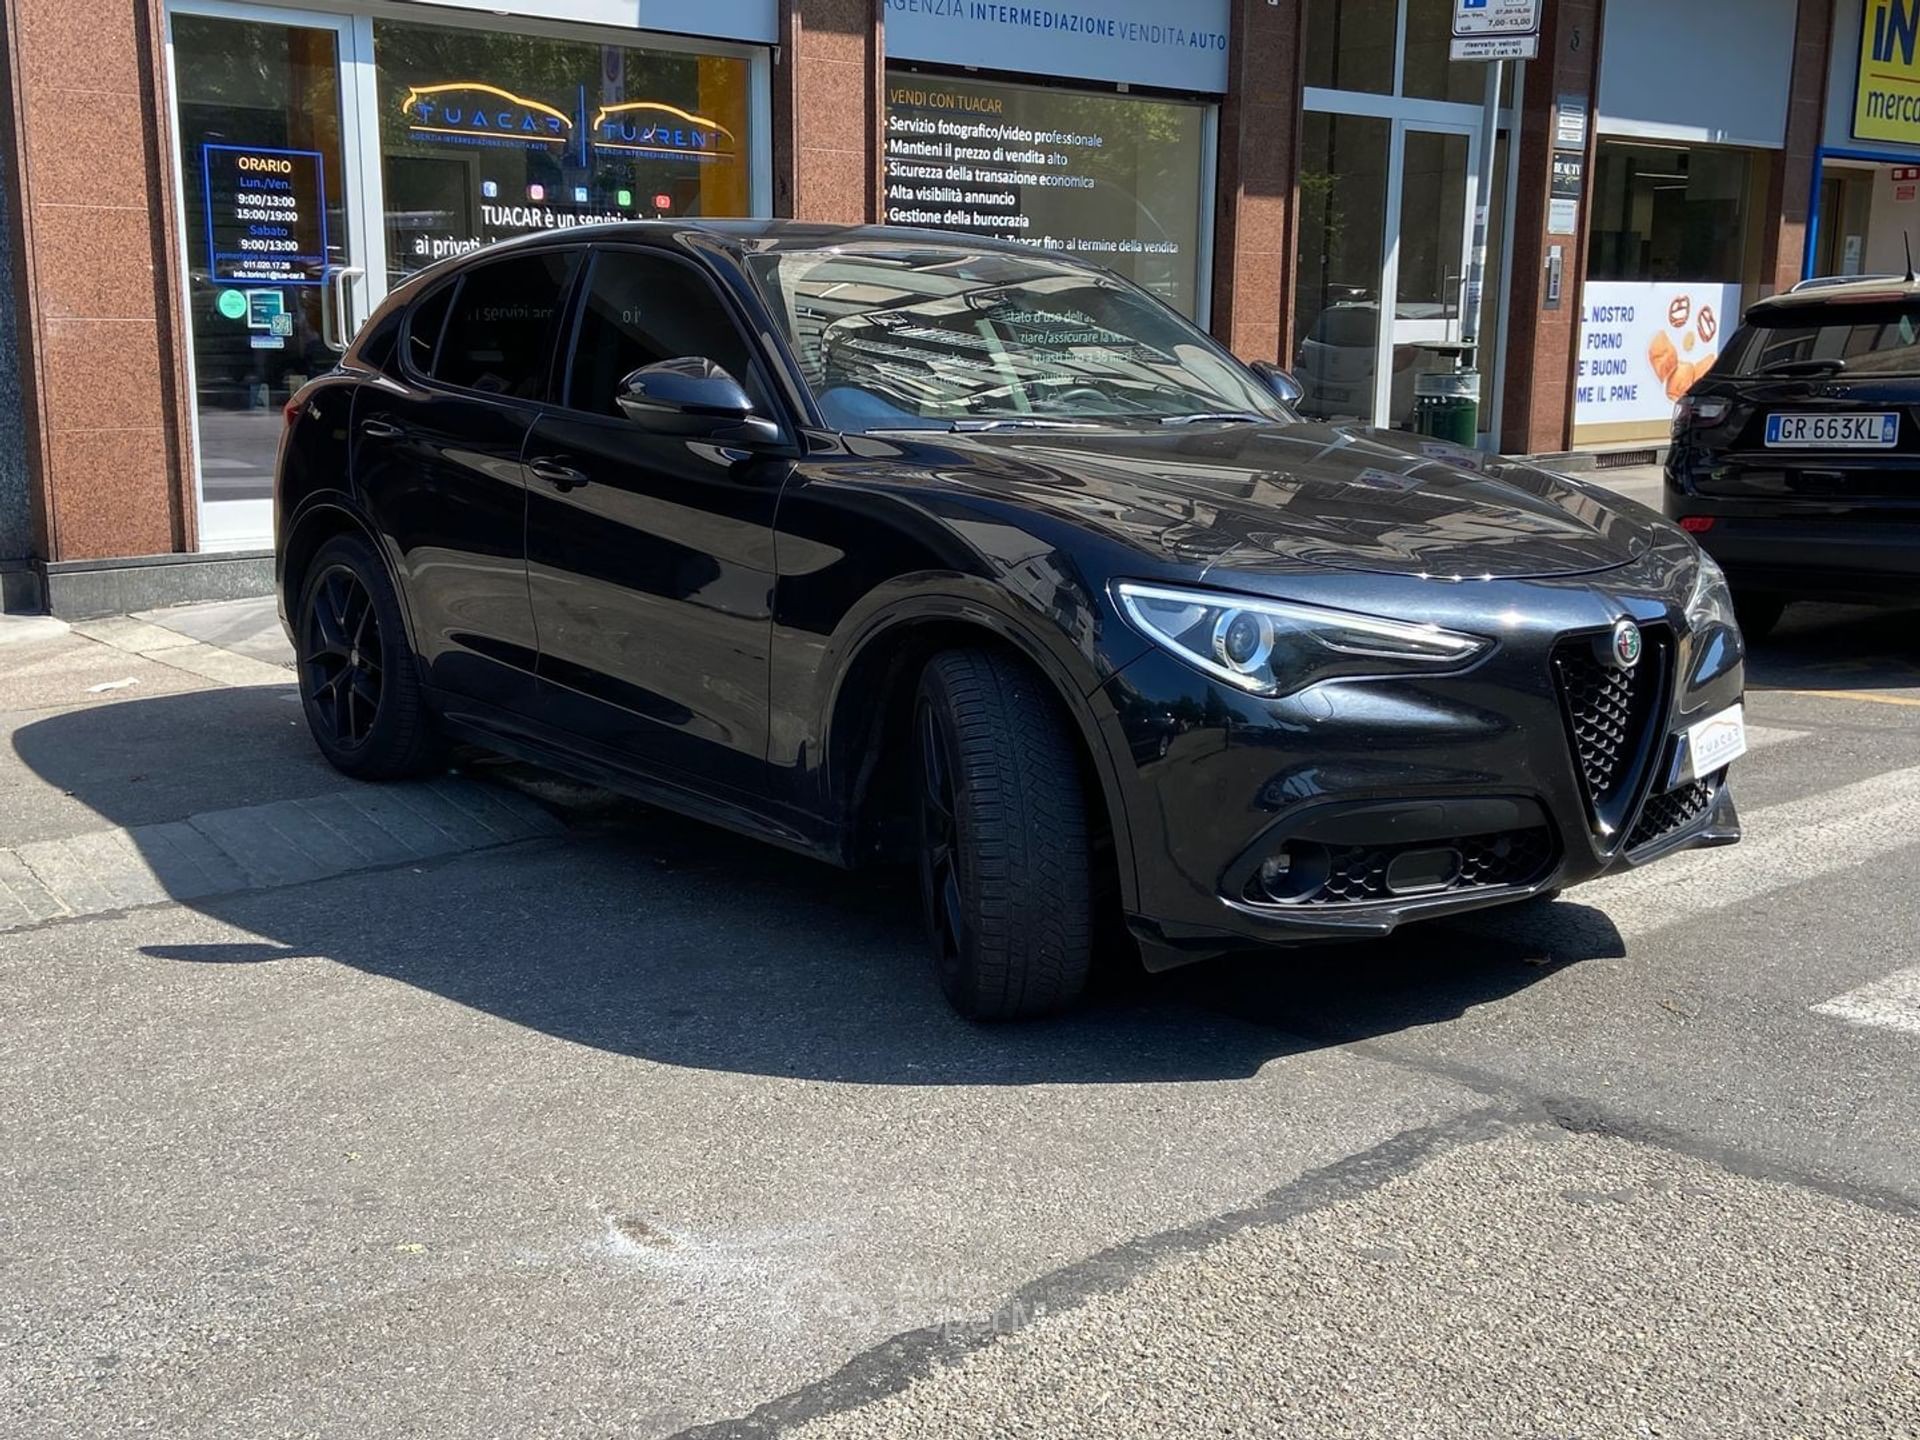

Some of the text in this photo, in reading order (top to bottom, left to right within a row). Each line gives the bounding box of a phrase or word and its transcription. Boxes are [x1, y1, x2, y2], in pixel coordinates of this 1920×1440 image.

[970, 2, 1115, 36] INTERMEDIAZIONE
[1118, 23, 1185, 46] VENDITA
[1189, 32, 1226, 50] AUTO
[890, 89, 1003, 113] VENDI CON TUACAR
[416, 103, 561, 132] TUACAR
[602, 123, 722, 148] TUARENT
[889, 116, 1103, 147] Servizio fotografico/video professionale
[890, 139, 1068, 166] Mantieni il prezzo di vendita alto
[238, 157, 292, 173] ORARIO
[889, 162, 1095, 189] Sicurezza della transazione economica
[239, 177, 292, 190] Lun./Ven.
[237, 193, 296, 208] 9:00/13:00
[889, 184, 1016, 206] Alta visibilità annuncio
[237, 208, 298, 222] 15:00/19:00
[481, 205, 542, 227] TUACAR
[545, 209, 554, 228] è
[557, 213, 576, 228] un
[889, 207, 1030, 228] Gestione della burocrazia
[249, 225, 288, 237] Sabato
[240, 239, 299, 252] 9:00/13:00
[415, 235, 481, 259] ai privati
[1044, 236, 1064, 250] fino
[1066, 237, 1076, 250] al
[1078, 239, 1117, 252] termine
[1118, 239, 1143, 253] della
[1145, 241, 1179, 254] vendita
[1592, 306, 1635, 323] NOSTRO
[1587, 332, 1623, 350] FORNO
[1591, 359, 1627, 376] BUONO
[1597, 386, 1607, 402] IL
[1610, 384, 1638, 402] PANE
[1781, 418, 1807, 440] GR
[1813, 418, 1880, 440] 663KL
